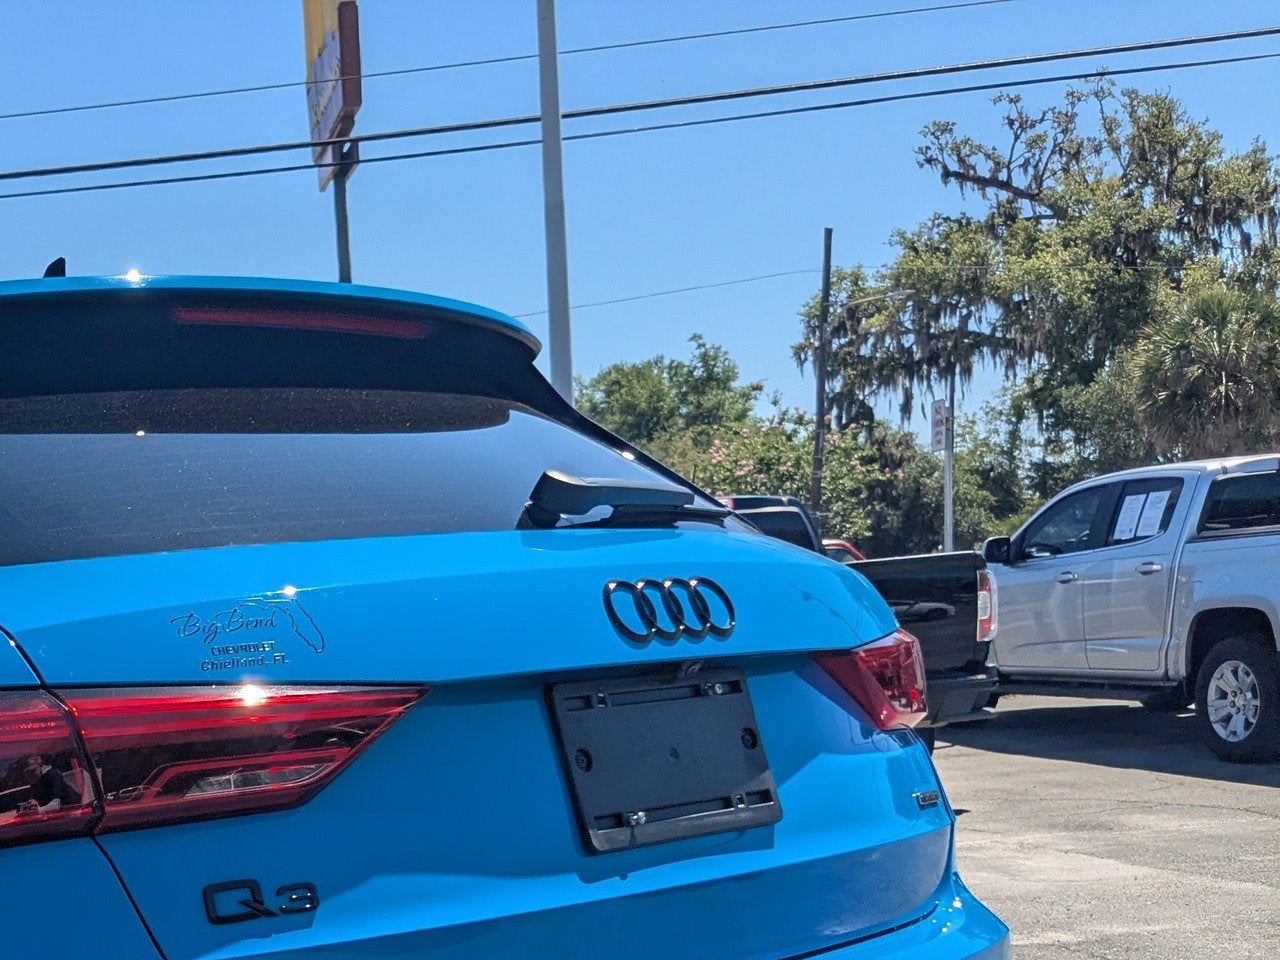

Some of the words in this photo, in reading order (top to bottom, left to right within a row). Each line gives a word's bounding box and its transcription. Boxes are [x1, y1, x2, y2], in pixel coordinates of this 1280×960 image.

[170, 612, 221, 645] Big
[214, 608, 278, 632] Bend
[210, 640, 275, 656] CHEVROLET
[273, 652, 289, 665] FL
[202, 878, 320, 926] Q3
